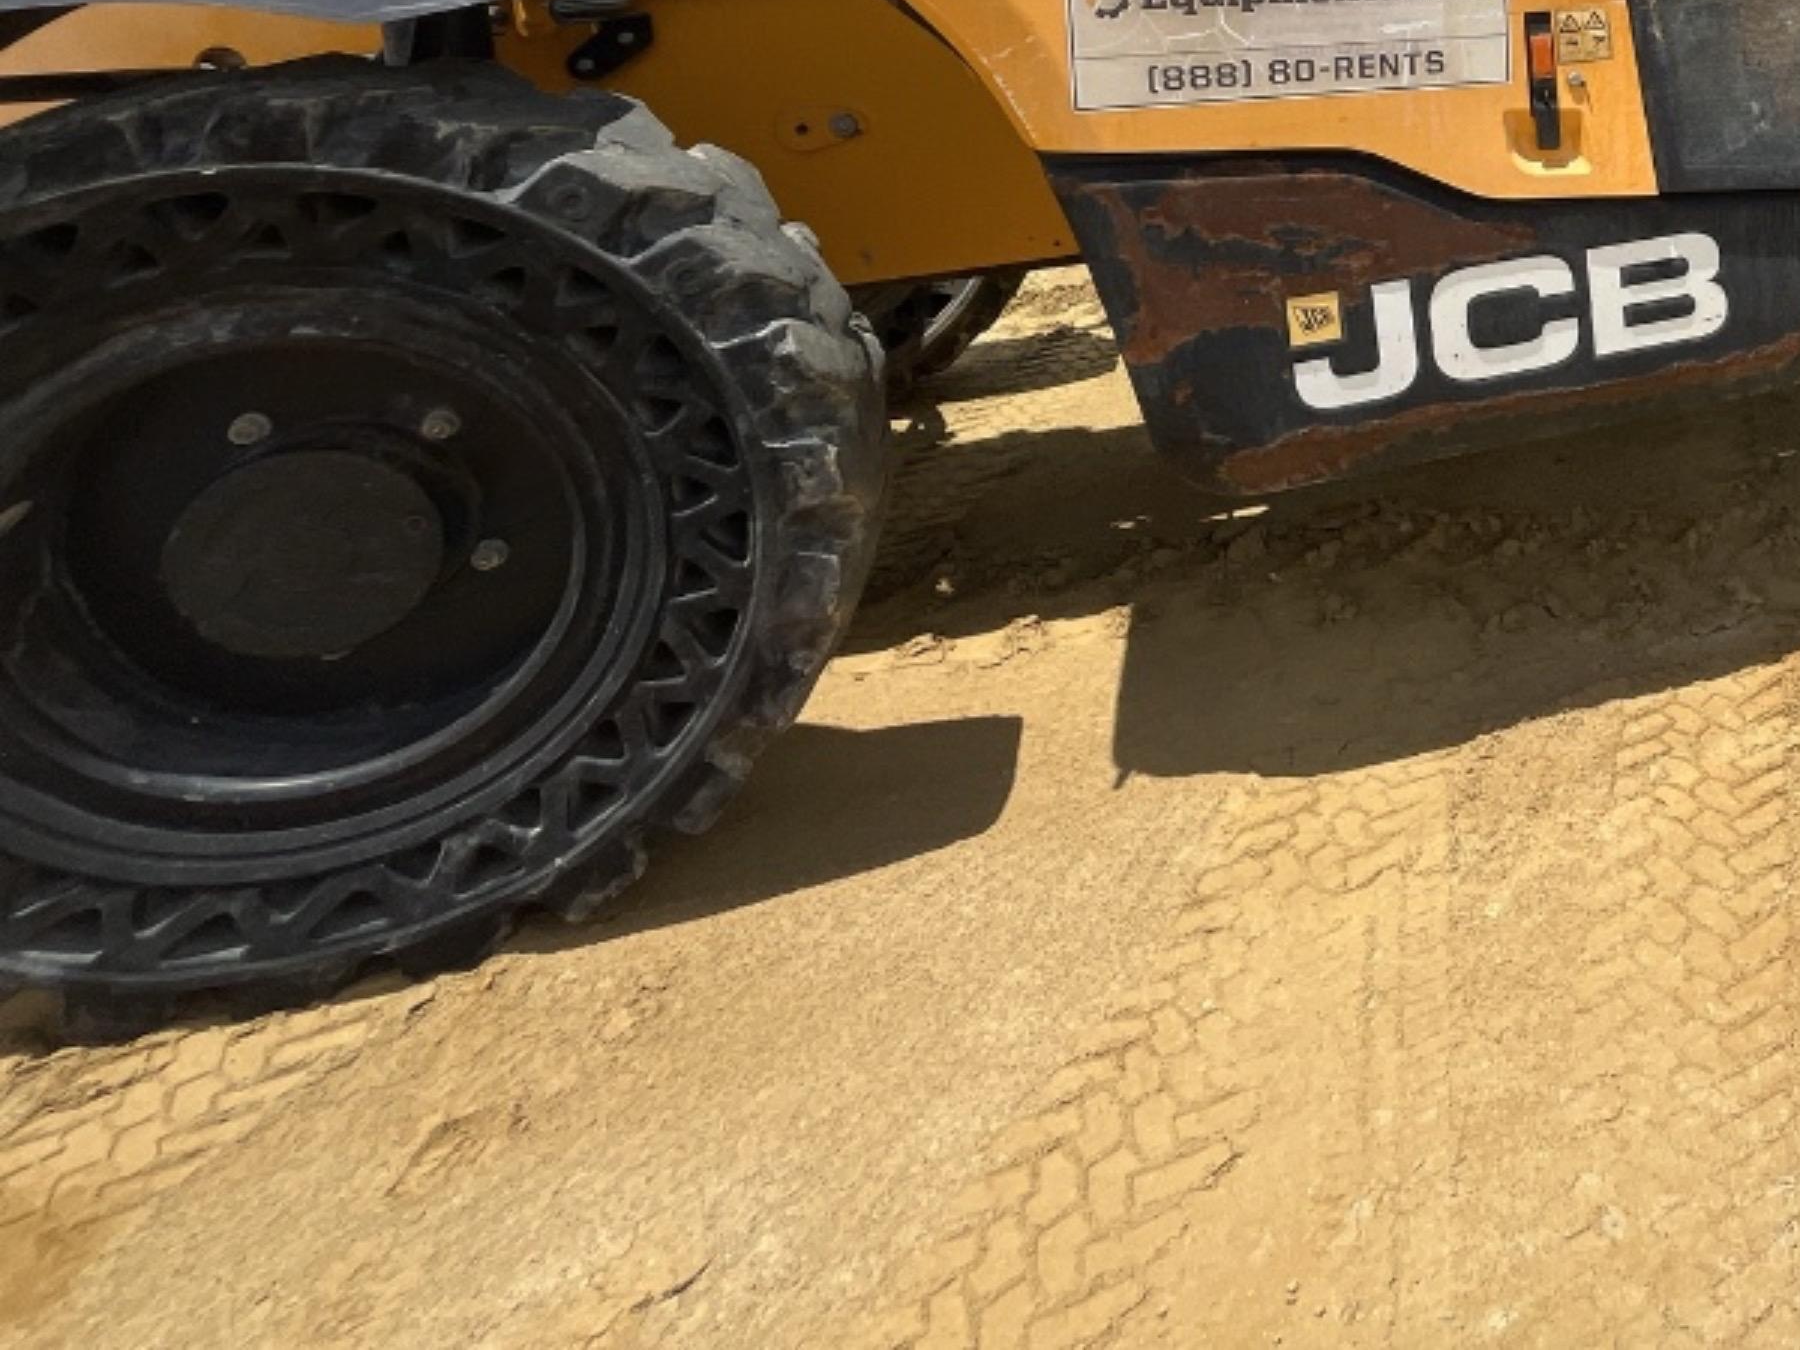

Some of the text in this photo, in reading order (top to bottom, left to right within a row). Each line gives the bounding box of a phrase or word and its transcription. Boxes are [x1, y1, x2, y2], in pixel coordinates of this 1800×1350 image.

[1148, 50, 1446, 93] (888) 80-RENTS
[1292, 232, 1729, 410] JCB
